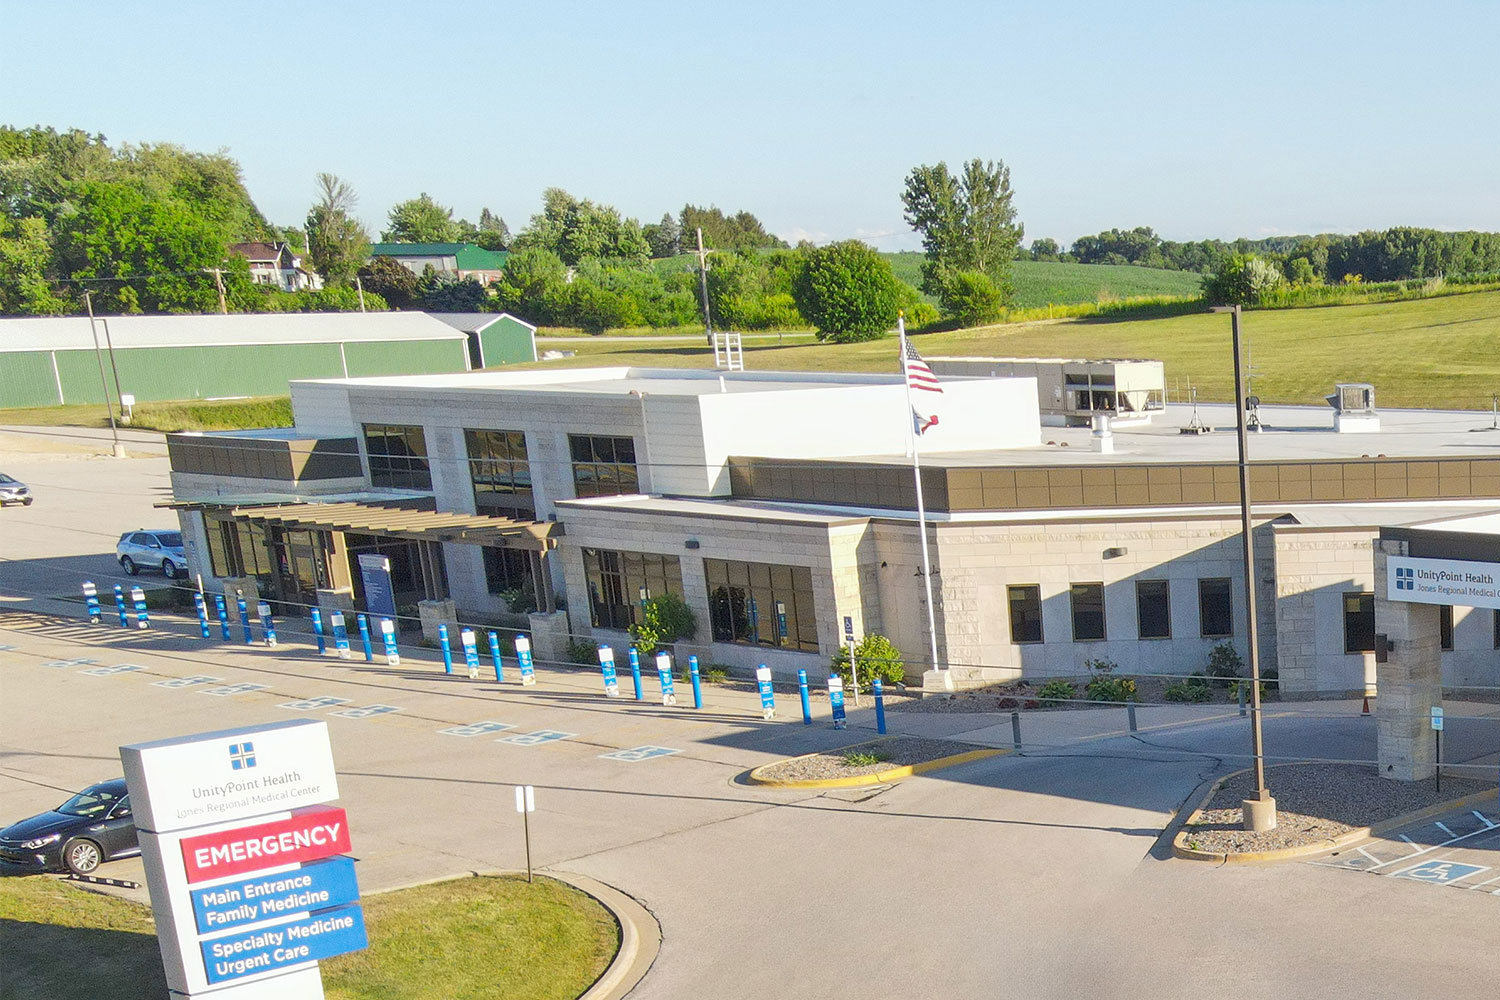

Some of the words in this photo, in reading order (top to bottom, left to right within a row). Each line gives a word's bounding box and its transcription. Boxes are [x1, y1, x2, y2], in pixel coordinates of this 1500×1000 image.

[1417, 569, 1463, 582] UnityPoint
[1465, 573, 1494, 584] Health
[1417, 584, 1436, 593] Jones
[1438, 586, 1467, 596] Regional
[1469, 588, 1496, 598] Medical
[192, 780, 259, 799] UnityPoint
[263, 770, 301, 787] Health
[207, 797, 250, 815] Regional
[252, 790, 289, 805] Medical
[290, 784, 321, 799] Center
[194, 823, 341, 869] EMERGENCY
[203, 887, 240, 908] Main
[245, 874, 312, 898] Entrance
[206, 905, 258, 927] Family
[262, 889, 329, 914] Medicine
[212, 929, 284, 958] Specialty
[288, 914, 354, 939] Medicine
[216, 954, 271, 976] Urgent
[274, 944, 309, 963] Care
